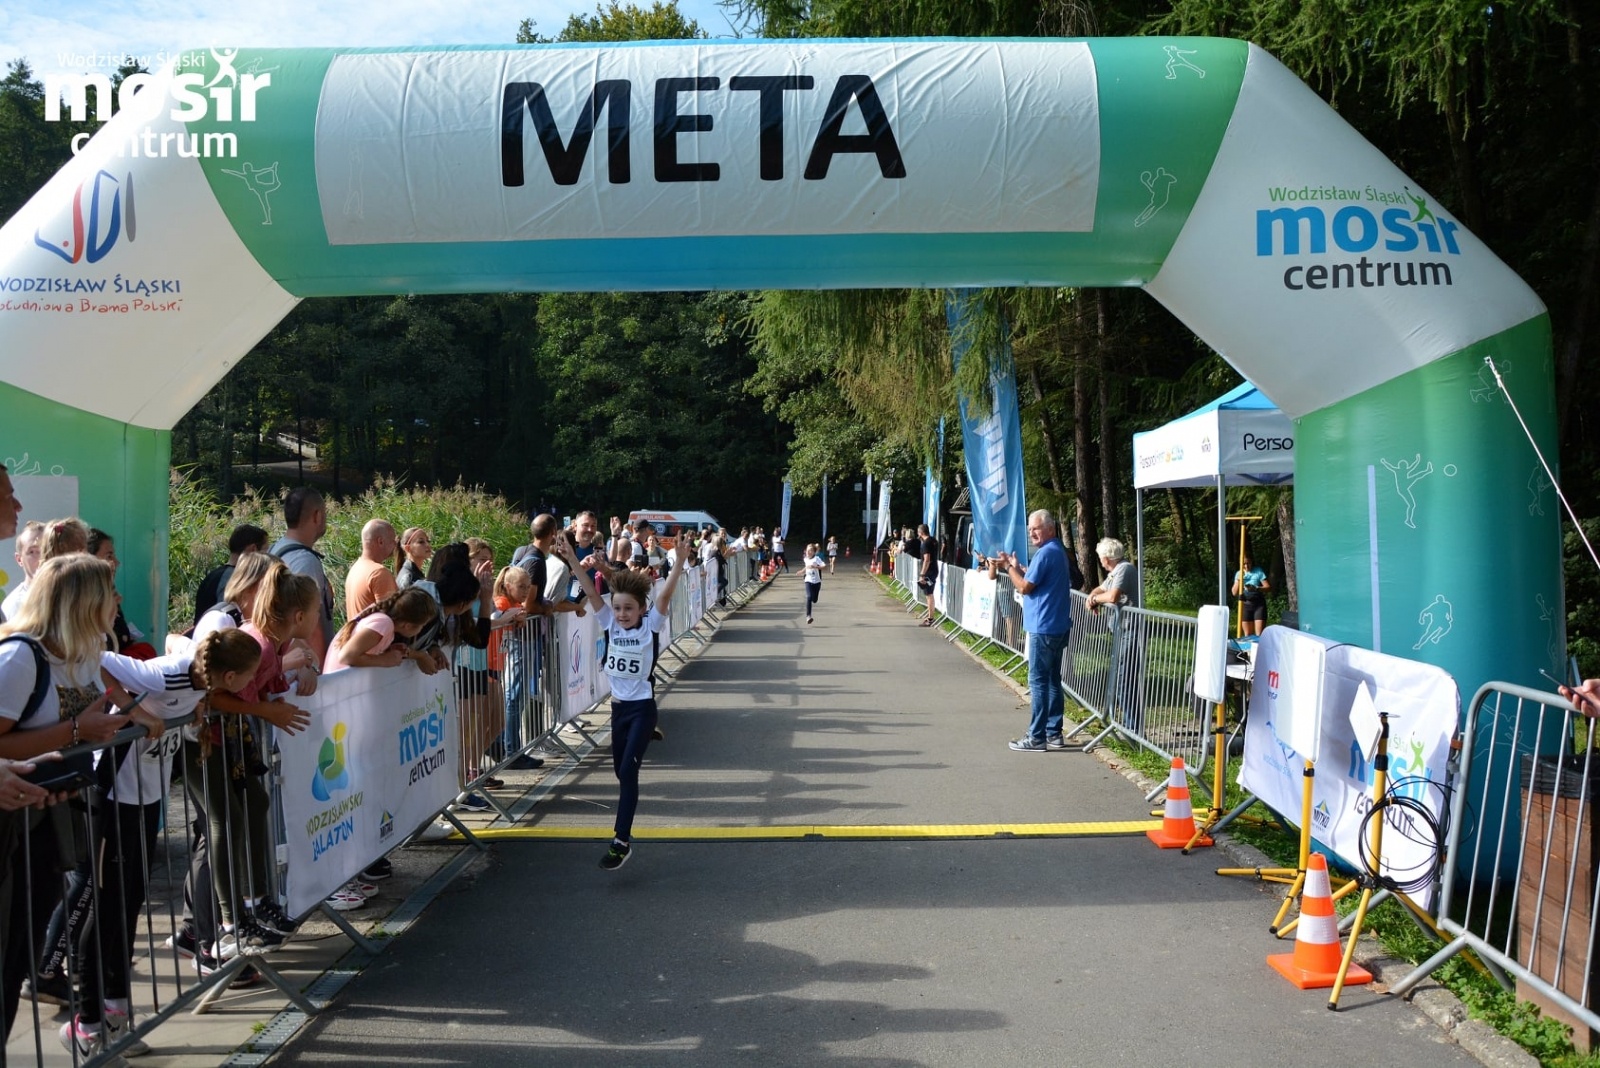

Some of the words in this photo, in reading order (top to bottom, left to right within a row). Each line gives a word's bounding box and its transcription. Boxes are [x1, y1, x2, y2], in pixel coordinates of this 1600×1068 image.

[502, 75, 907, 187] META
[1268, 185, 1361, 202] Wodzisław
[1365, 185, 1408, 206] Śląski
[1256, 203, 1461, 256] mosir
[113, 273, 181, 297] ŚLĄSKI
[1283, 256, 1453, 290] centrum
[79, 298, 129, 314] Brama
[132, 298, 183, 313] Polski
[1243, 433, 1294, 451] Perso
[608, 655, 640, 674] 365
[146, 733, 179, 759] 413
